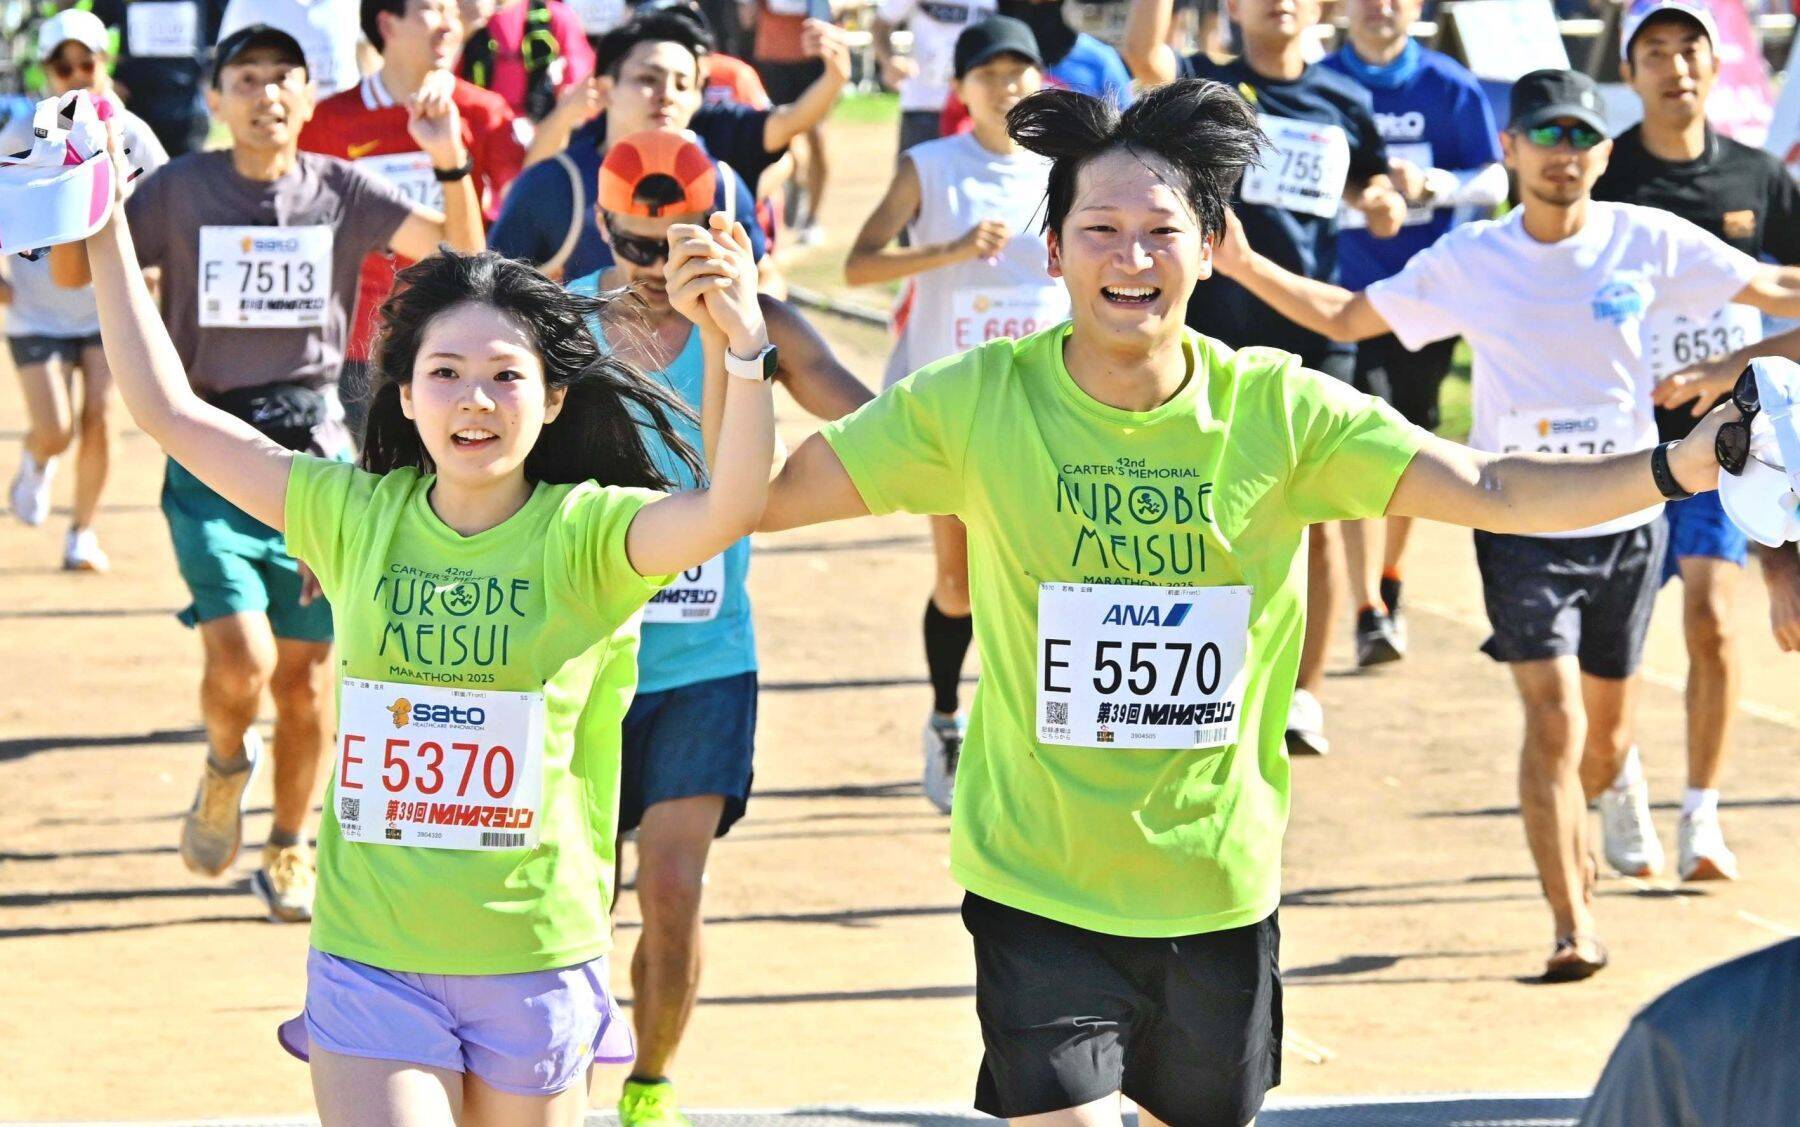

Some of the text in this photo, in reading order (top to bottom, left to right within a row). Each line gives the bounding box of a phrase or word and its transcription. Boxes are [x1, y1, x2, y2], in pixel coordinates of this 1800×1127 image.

[1372, 111, 1425, 137] ato
[205, 261, 314, 293] F 7513
[956, 317, 973, 350] E
[1063, 464, 1200, 479] CARTER'S MEMORIAL
[1116, 457, 1146, 468] 42nd
[1072, 525, 1206, 576] MEISUI
[390, 563, 449, 581] CARTER'S
[445, 567, 474, 577] 42nd
[1101, 604, 1160, 627] ANA
[378, 621, 509, 666] MEISUI
[389, 665, 495, 683] MARATHON 2025
[1044, 638, 1221, 696] E 5570
[412, 703, 486, 725] sato
[340, 734, 515, 799] E 5370
